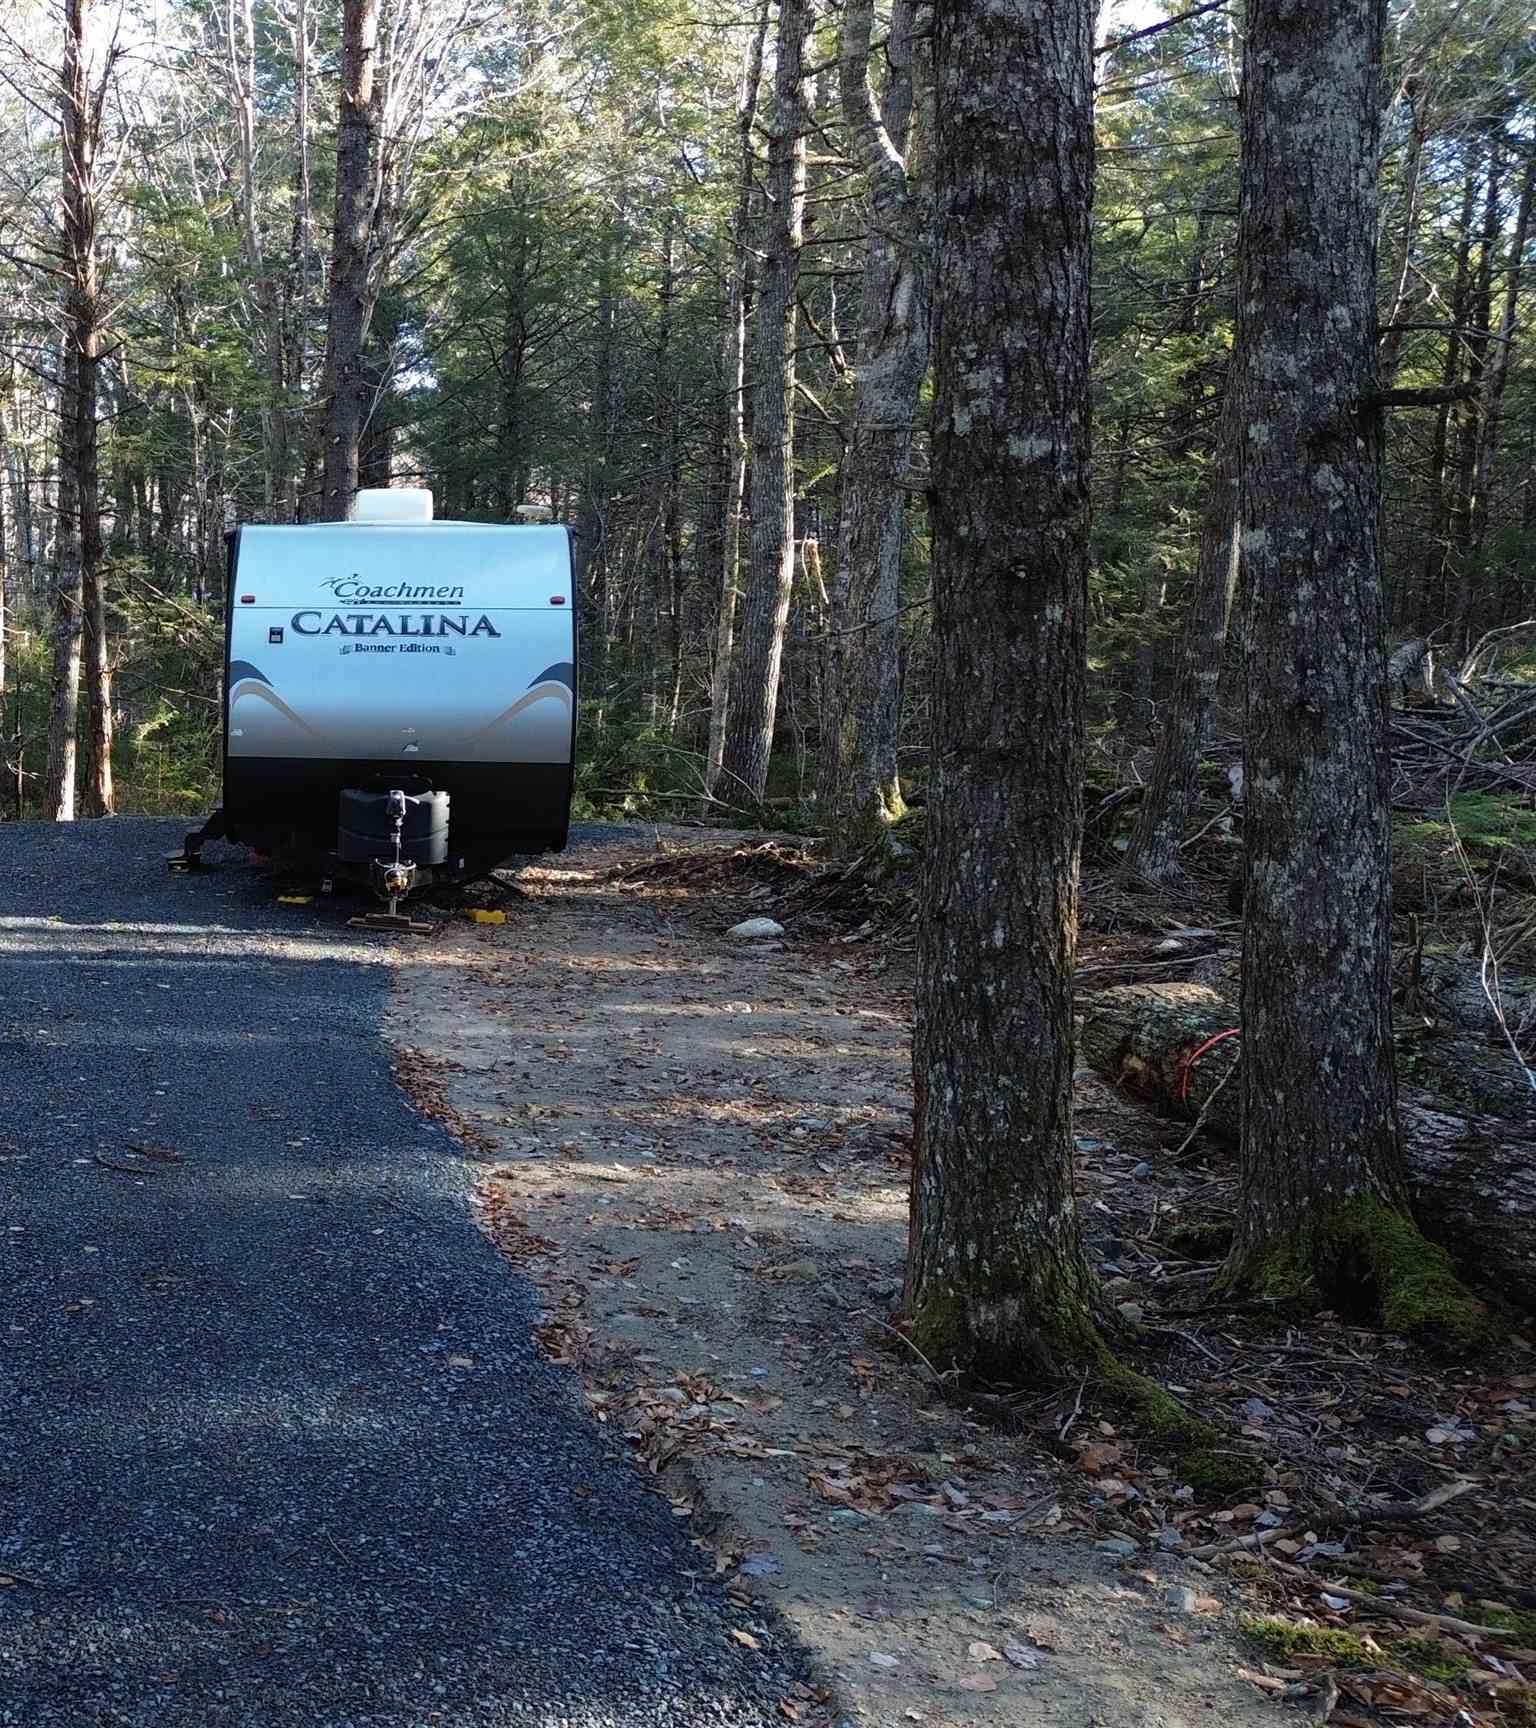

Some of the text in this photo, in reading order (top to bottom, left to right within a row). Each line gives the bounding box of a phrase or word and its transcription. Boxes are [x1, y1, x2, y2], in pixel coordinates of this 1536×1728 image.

[333, 581, 464, 599] Coachmen
[290, 611, 502, 638] CATALINA
[354, 643, 440, 654] Banner Edition
